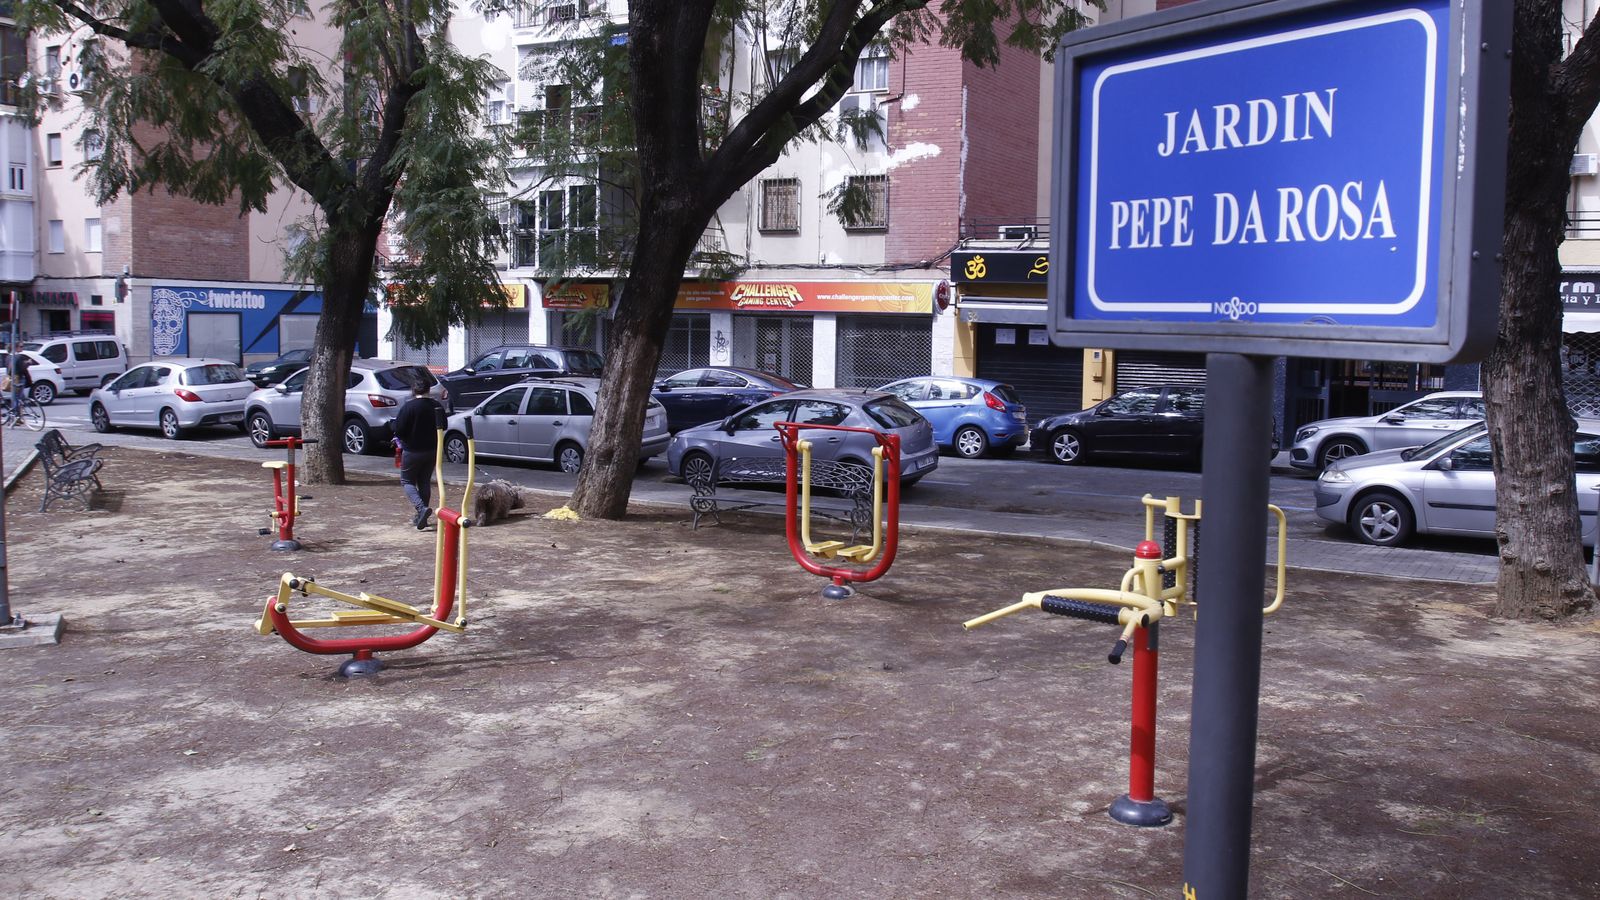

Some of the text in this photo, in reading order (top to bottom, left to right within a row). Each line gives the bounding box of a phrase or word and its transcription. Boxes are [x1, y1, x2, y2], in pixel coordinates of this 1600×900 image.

[1157, 87, 1338, 157] JARDIN
[1108, 179, 1397, 250] PEPE DA ROSA
[208, 289, 266, 310] twotattoo
[729, 283, 804, 302] CHALLENGER
[737, 297, 795, 308] GAMING CENTER
[816, 293, 915, 303] www.challengergamingcenter.com
